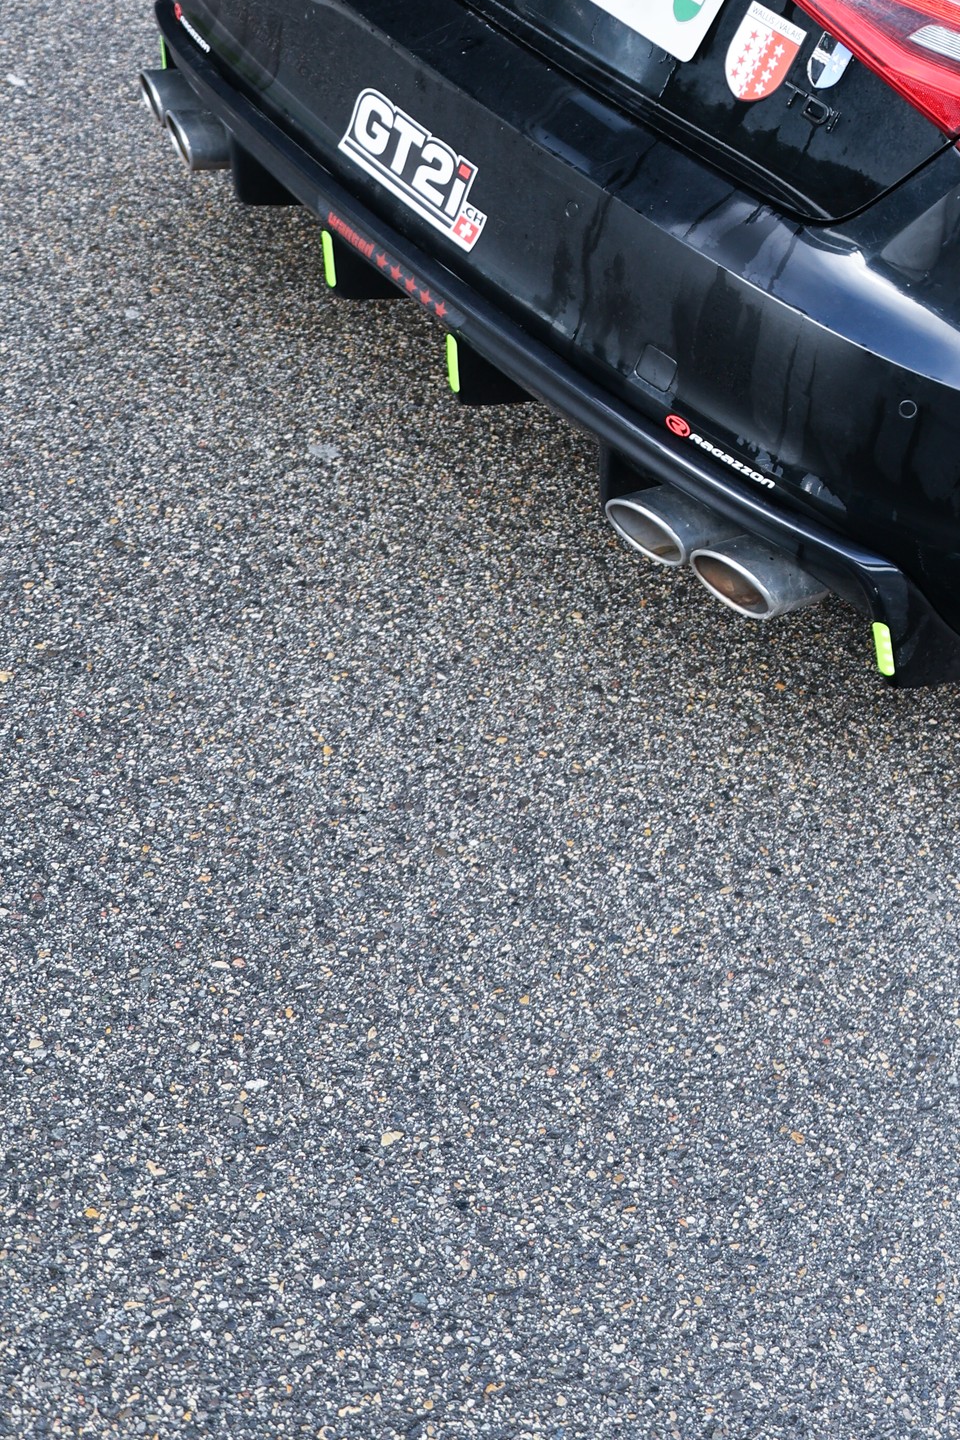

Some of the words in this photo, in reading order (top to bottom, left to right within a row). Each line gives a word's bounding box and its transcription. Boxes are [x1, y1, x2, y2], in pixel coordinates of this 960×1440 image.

[752, 5, 775, 25] WALLIS
[779, 23, 804, 41] VALAIS
[785, 80, 842, 133] TDI
